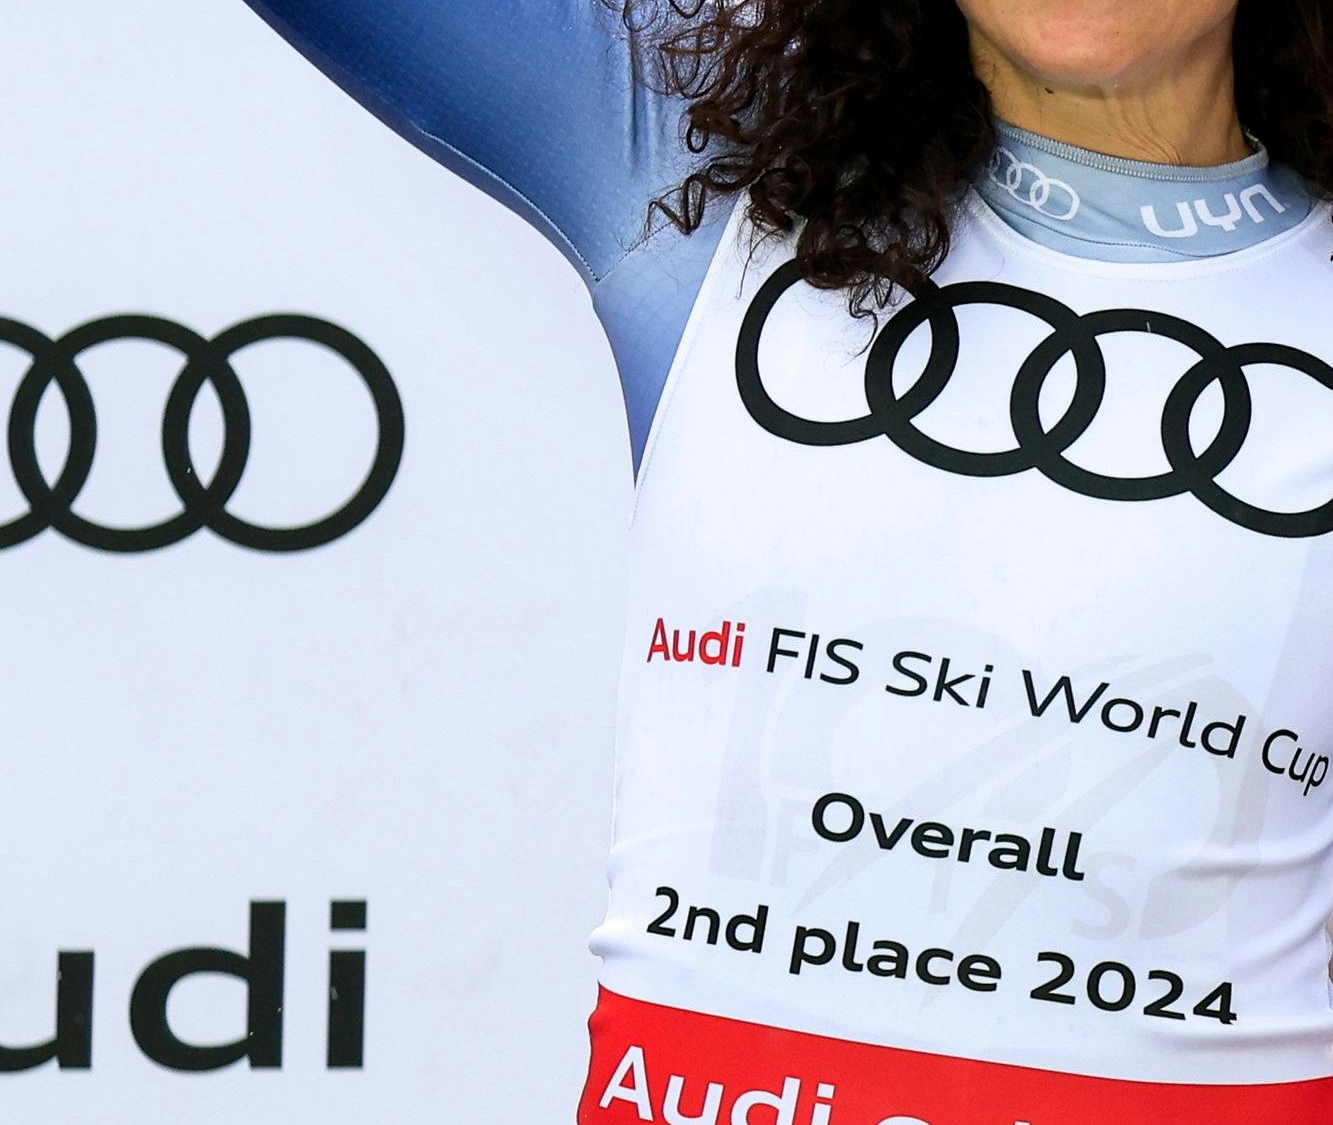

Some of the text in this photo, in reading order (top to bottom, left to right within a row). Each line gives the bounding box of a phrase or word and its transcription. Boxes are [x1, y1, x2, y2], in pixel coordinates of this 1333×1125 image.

[647, 618, 1330, 797] Audi FIS Ski World Cup
[811, 792, 1086, 882] Overall
[0, 900, 367, 1073] udi
[645, 886, 1238, 1026] 2nd place 2024
